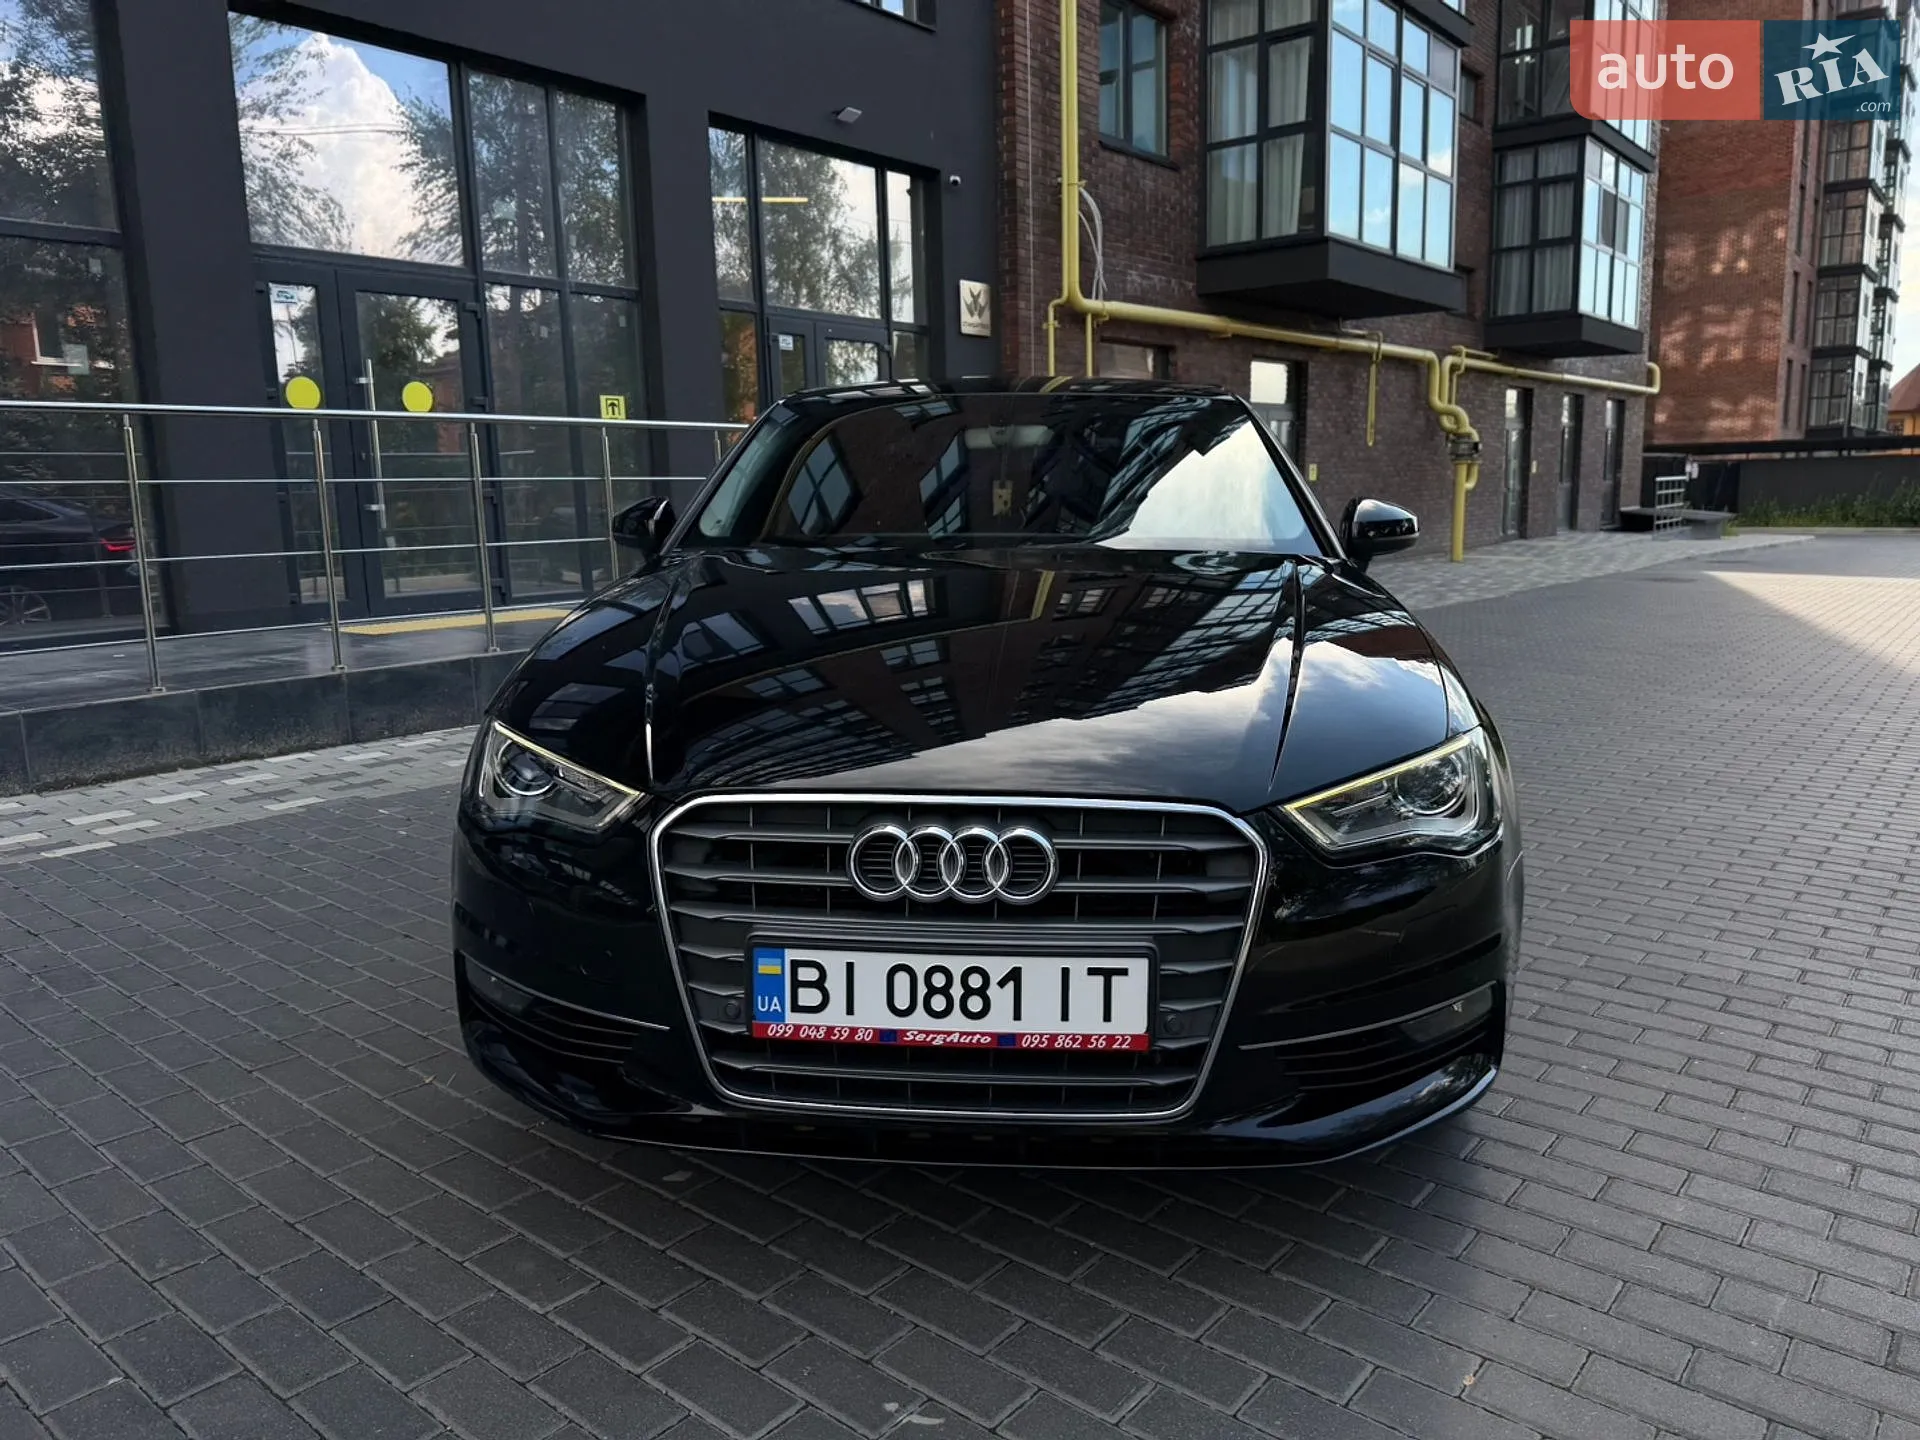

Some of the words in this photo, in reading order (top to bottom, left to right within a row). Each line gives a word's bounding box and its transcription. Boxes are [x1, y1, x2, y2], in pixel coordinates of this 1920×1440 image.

[757, 994, 782, 1013] UA
[789, 958, 856, 1016] BI
[886, 962, 1022, 1022] 0881
[1061, 966, 1129, 1023] IT
[767, 1023, 794, 1037] 099
[800, 1027, 827, 1039] 048
[831, 1028, 850, 1040] 59
[855, 1028, 874, 1042] 80
[903, 1030, 992, 1046] SergAuto
[1022, 1034, 1050, 1048] 095
[1054, 1035, 1083, 1049] 862
[1087, 1036, 1107, 1048] 56
[1112, 1036, 1132, 1049] 22
